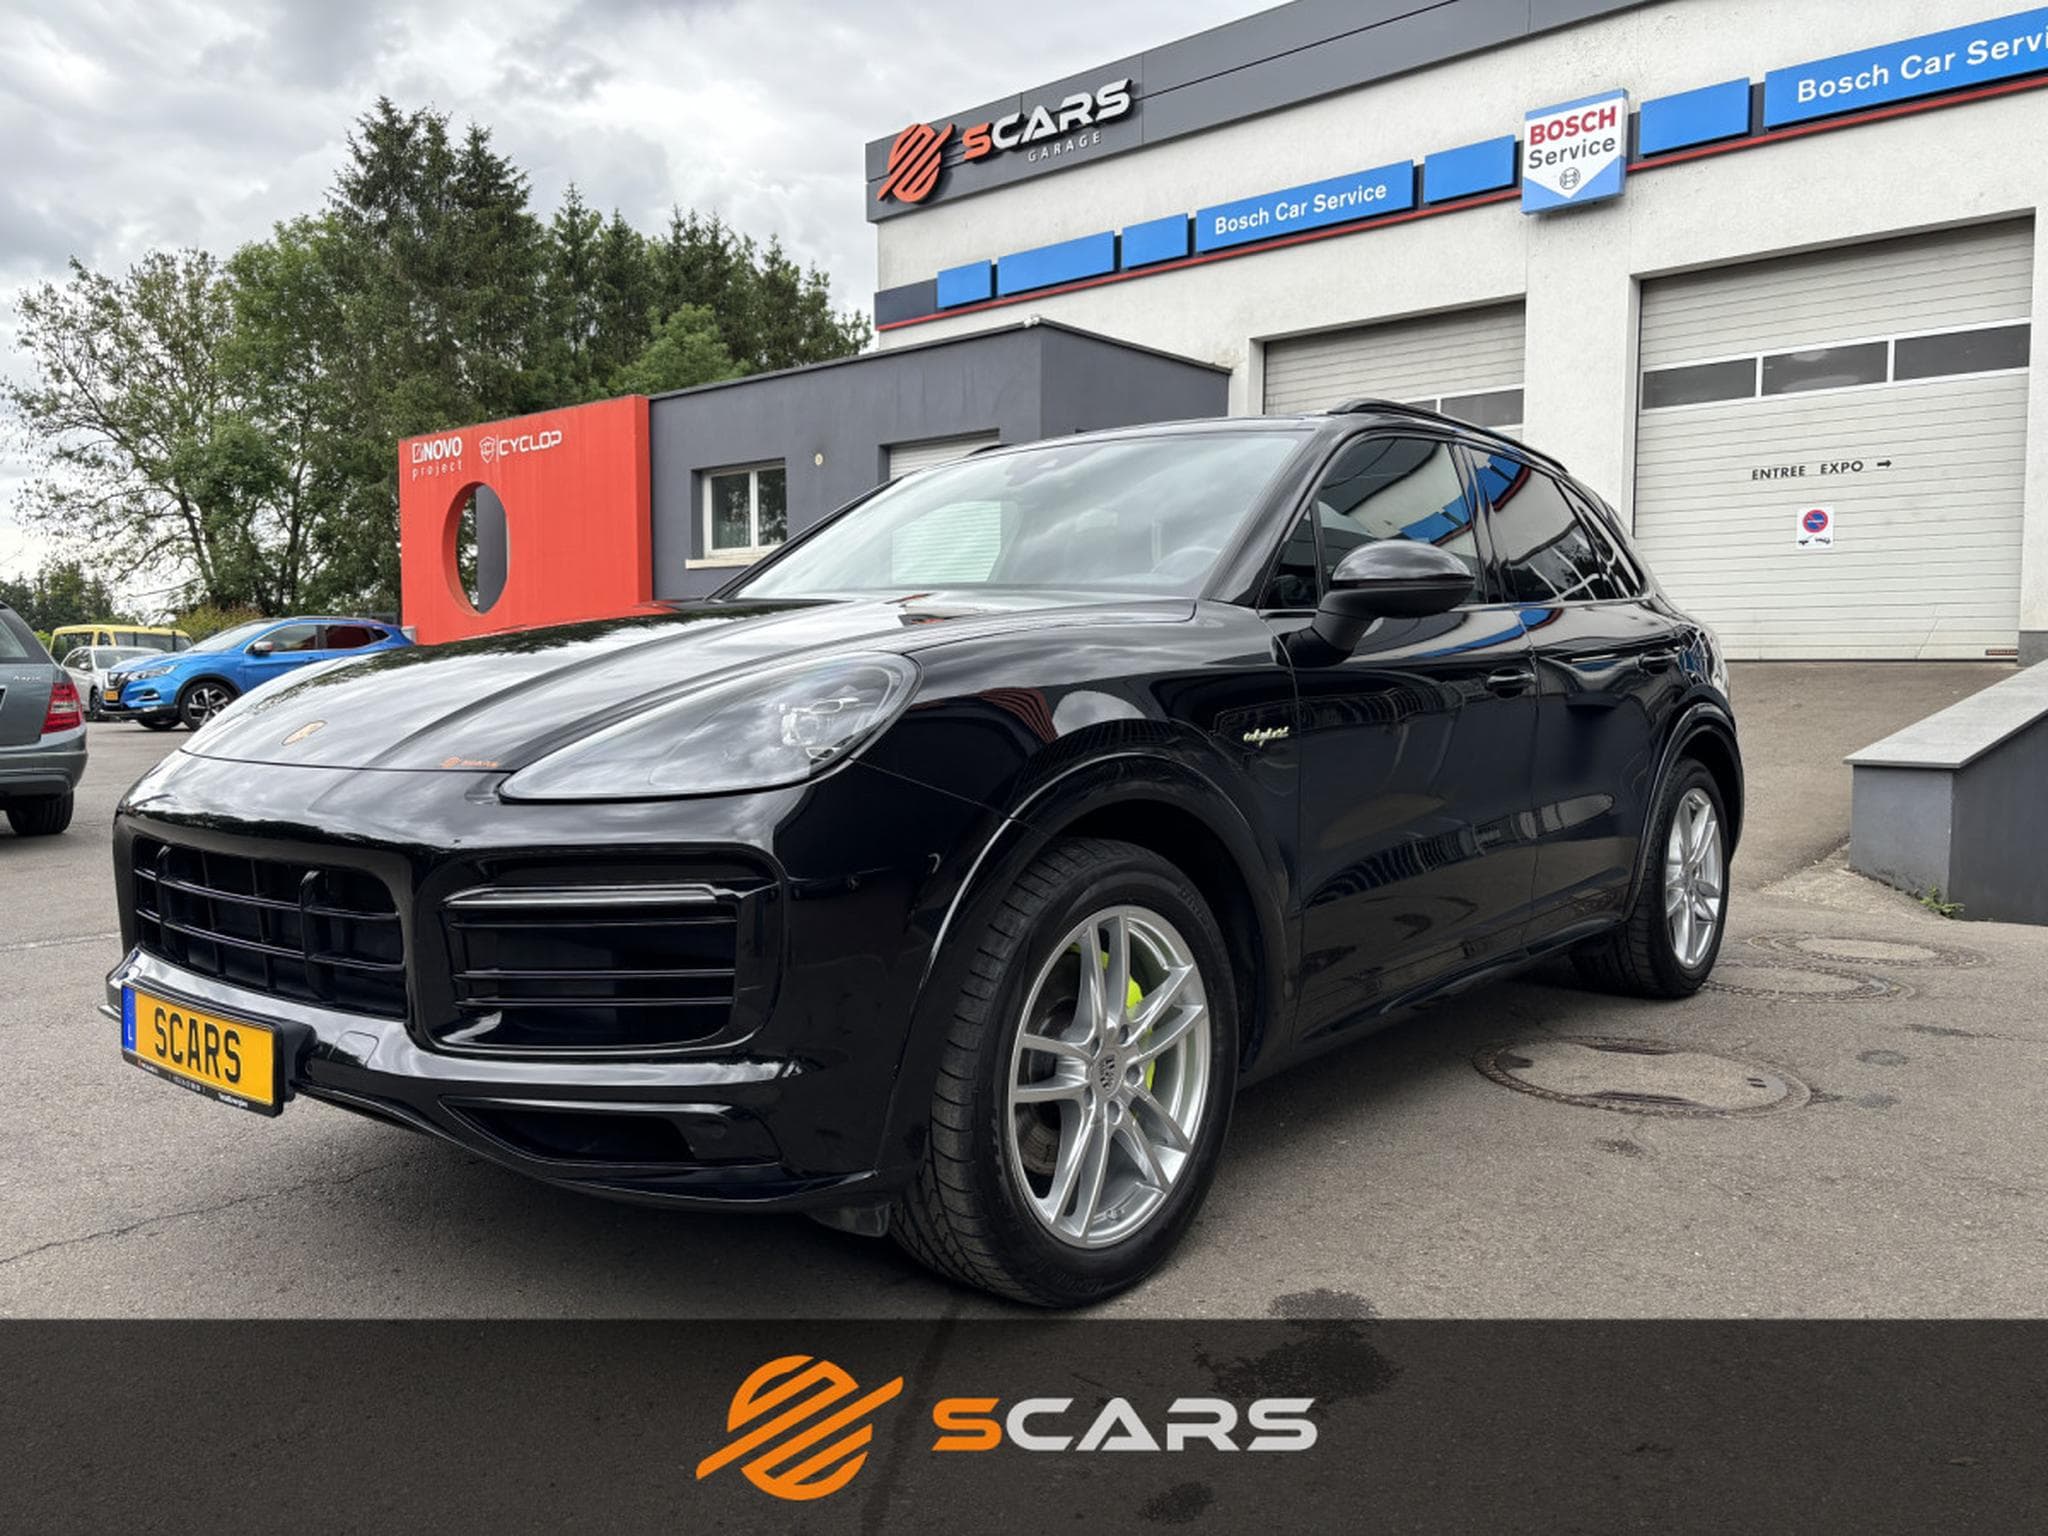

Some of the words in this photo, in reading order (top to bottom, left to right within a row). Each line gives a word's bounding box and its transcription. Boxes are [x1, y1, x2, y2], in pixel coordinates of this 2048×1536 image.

[1797, 64, 1889, 103] Bosch
[1900, 52, 1956, 80] Car
[1529, 105, 1617, 146] BOSCH
[1027, 131, 1102, 162] GARAGE
[1528, 137, 1616, 169] Service
[1215, 207, 1270, 235] Bosch
[1274, 202, 1308, 222] Car
[1313, 184, 1387, 213] Service
[499, 430, 562, 456] CYCLOP
[412, 460, 463, 481] project
[1751, 465, 1806, 480] ENTREE
[1820, 460, 1864, 475] EXPO
[154, 1007, 241, 1084] SCARS
